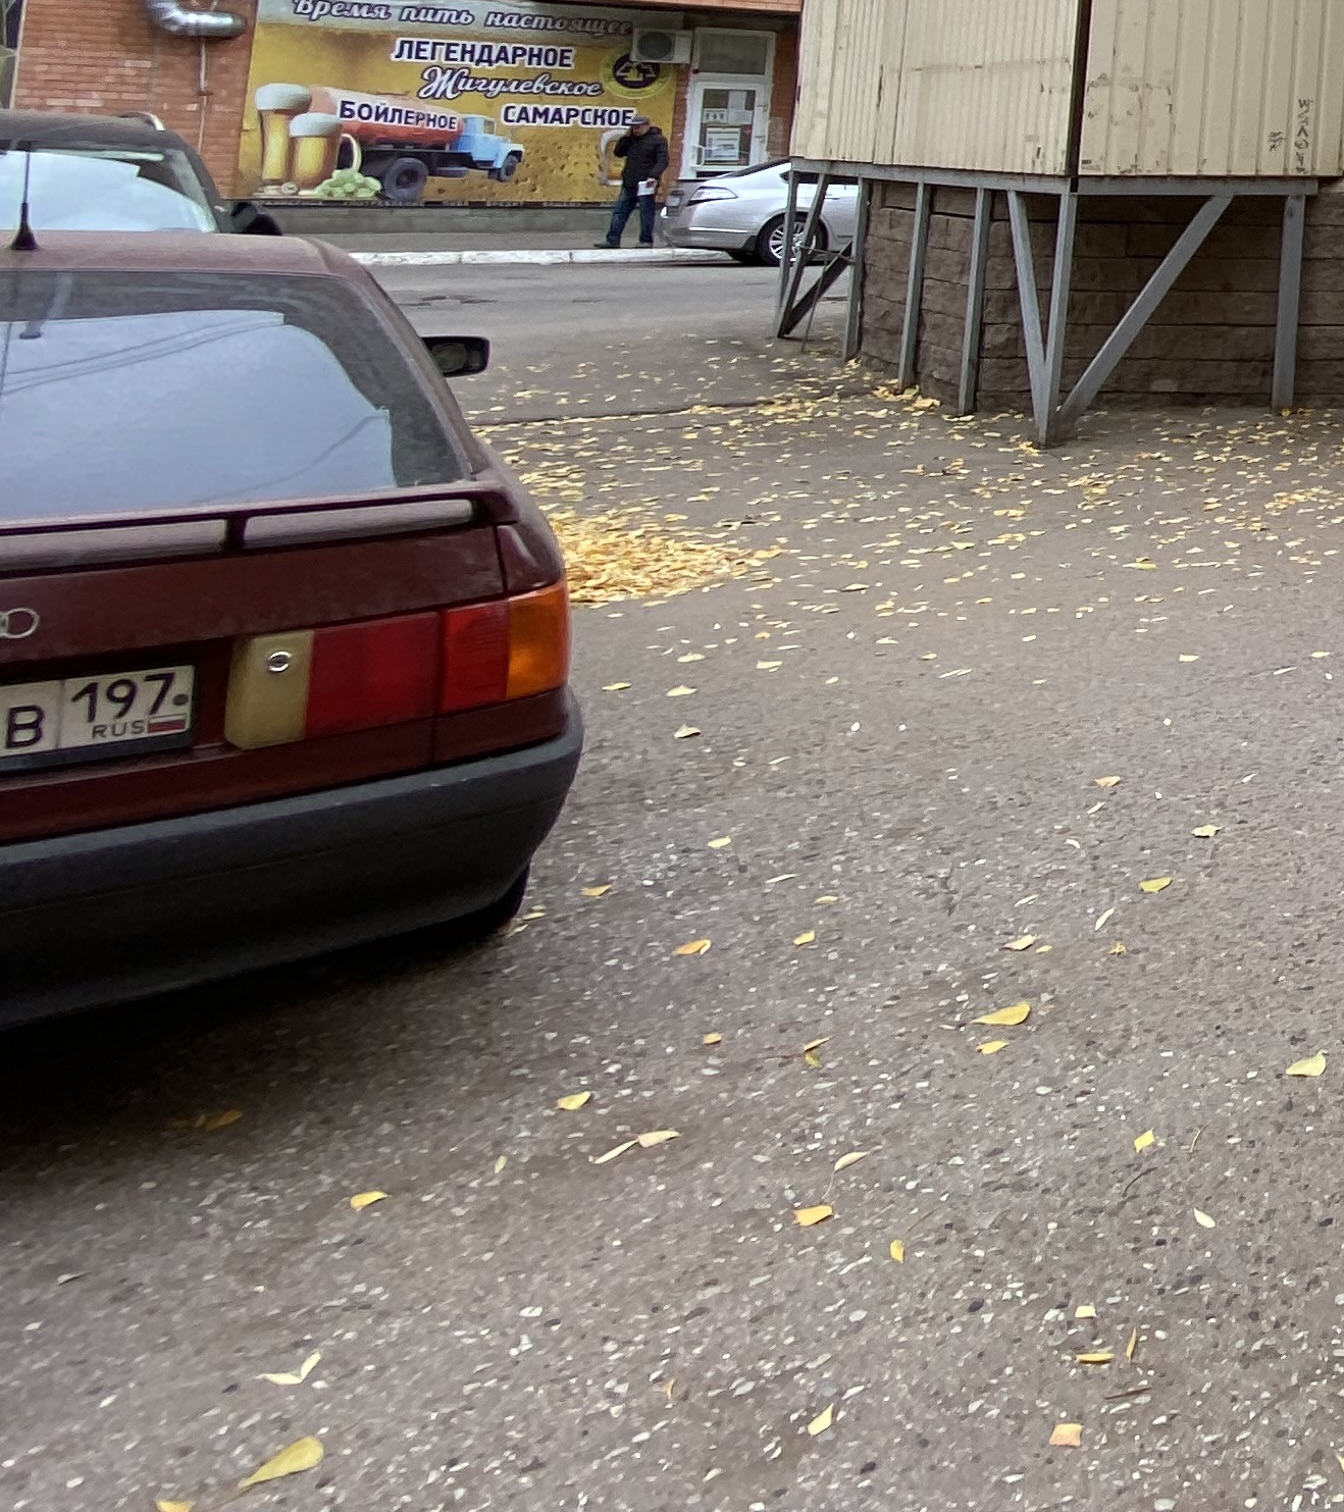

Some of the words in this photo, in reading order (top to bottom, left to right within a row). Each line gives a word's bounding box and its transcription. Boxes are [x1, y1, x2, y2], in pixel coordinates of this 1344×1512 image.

[400, 5, 475, 26] пить
[484, 11, 634, 37] настоящее
[394, 39, 573, 68] ЛЕГЕНДАРНОЕ
[417, 65, 604, 100] Жигулевское
[339, 99, 458, 130] БОЙЛЕРНОЕ
[502, 104, 634, 126] САМАРСКОЕ
[71, 672, 176, 724] 197
[91, 719, 145, 740] RUS
